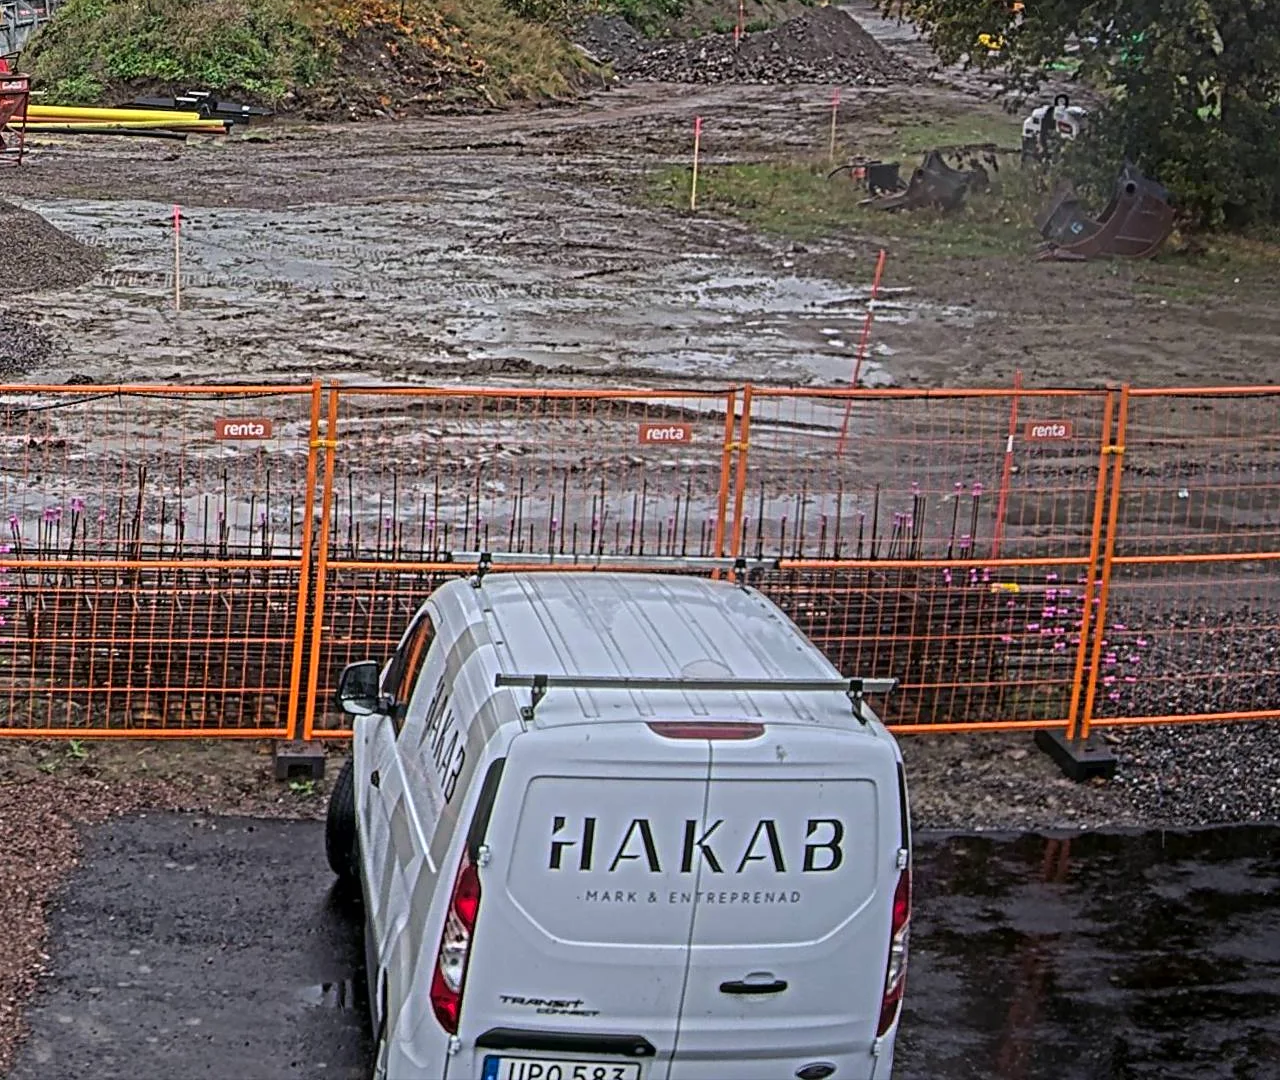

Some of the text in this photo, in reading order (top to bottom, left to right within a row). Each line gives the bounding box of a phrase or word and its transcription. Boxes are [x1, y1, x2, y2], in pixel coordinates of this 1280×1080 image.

[224, 422, 264, 436] renta
[646, 426, 684, 440] renta
[1031, 424, 1066, 437] renta
[549, 816, 845, 873] HAKAB
[585, 890, 802, 905] MARK & ENTREPRENAD
[573, 1066, 626, 1080] 583
